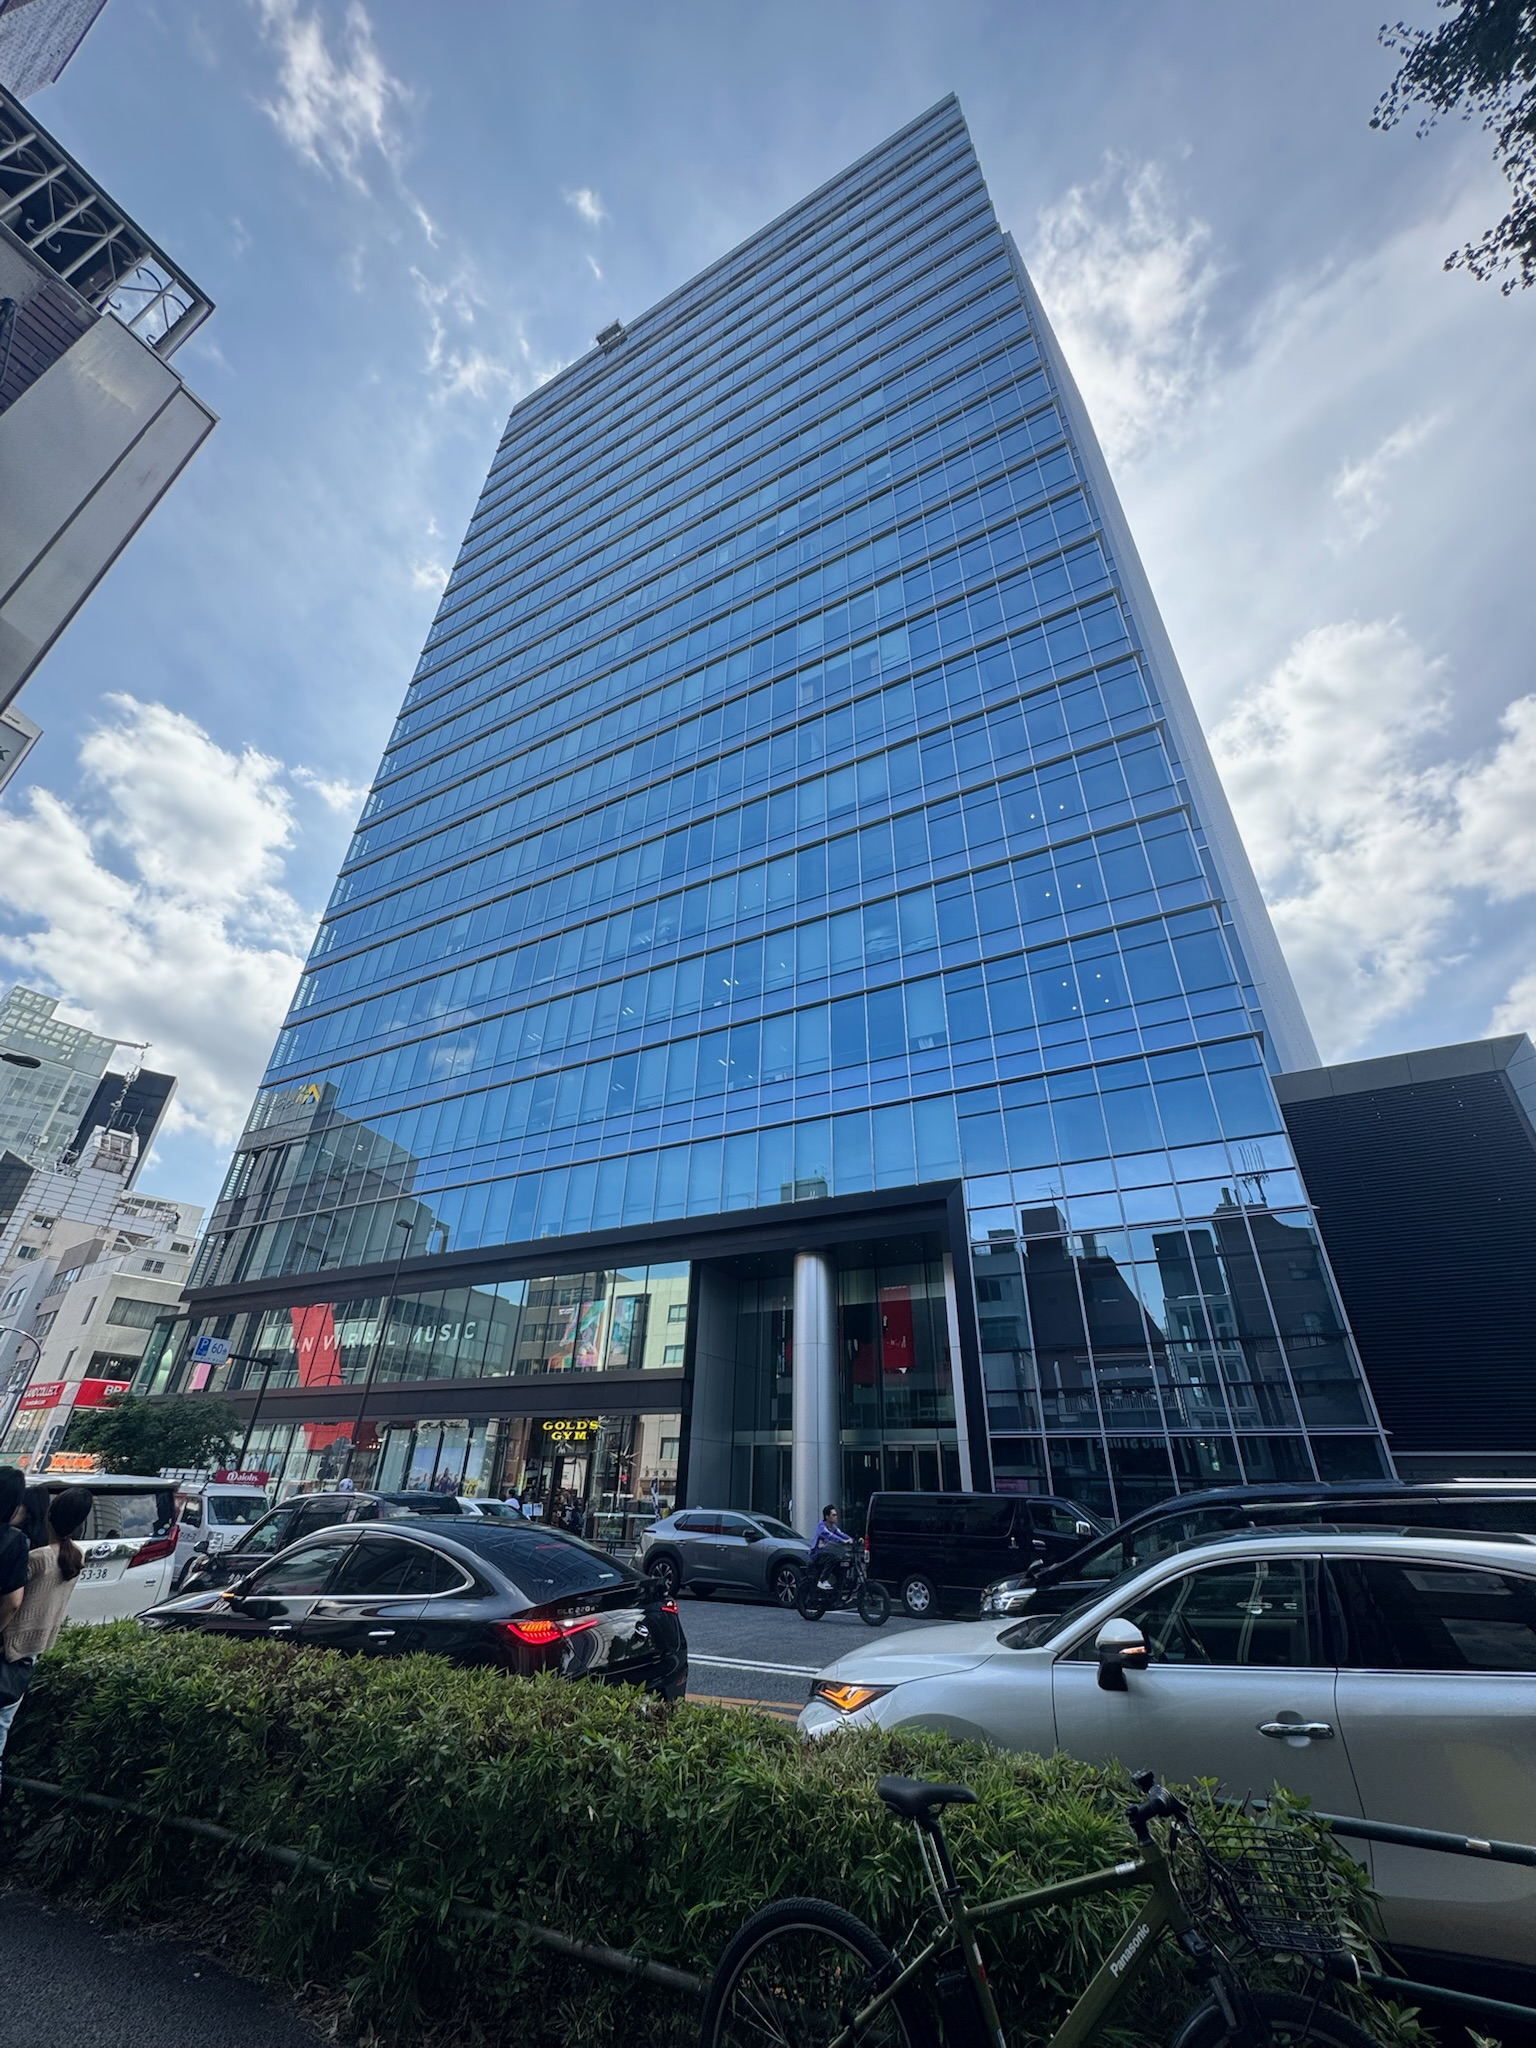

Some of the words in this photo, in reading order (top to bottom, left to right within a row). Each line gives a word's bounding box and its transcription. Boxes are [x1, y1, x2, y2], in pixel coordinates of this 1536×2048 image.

[542, 1420, 600, 1430] GOLD'S
[551, 1431, 587, 1440] GYM
[80, 1568, 108, 1580] 53-38
[1109, 1923, 1151, 1978] Panasonic
